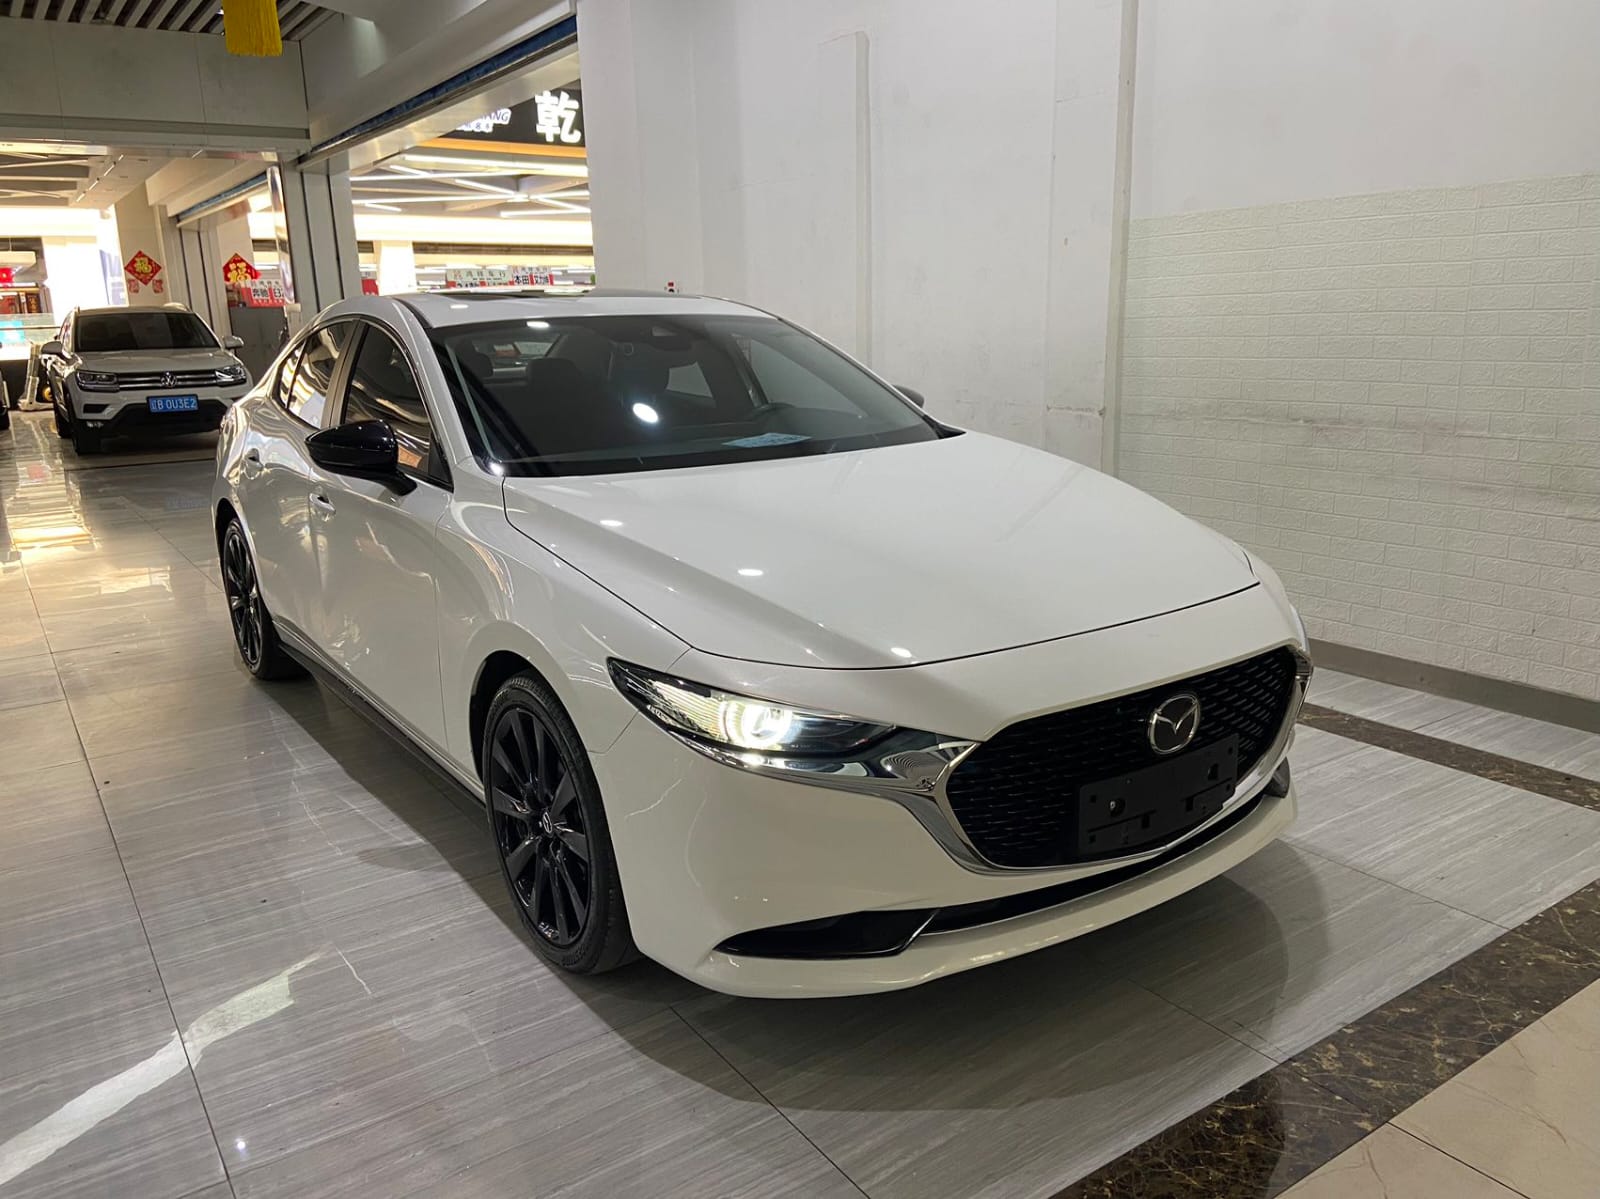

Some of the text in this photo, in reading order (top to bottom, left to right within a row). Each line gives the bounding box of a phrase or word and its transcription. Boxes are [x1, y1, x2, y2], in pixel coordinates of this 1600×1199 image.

[535, 90, 581, 143] 乾
[134, 256, 152, 273] 福
[228, 262, 252, 284] 福
